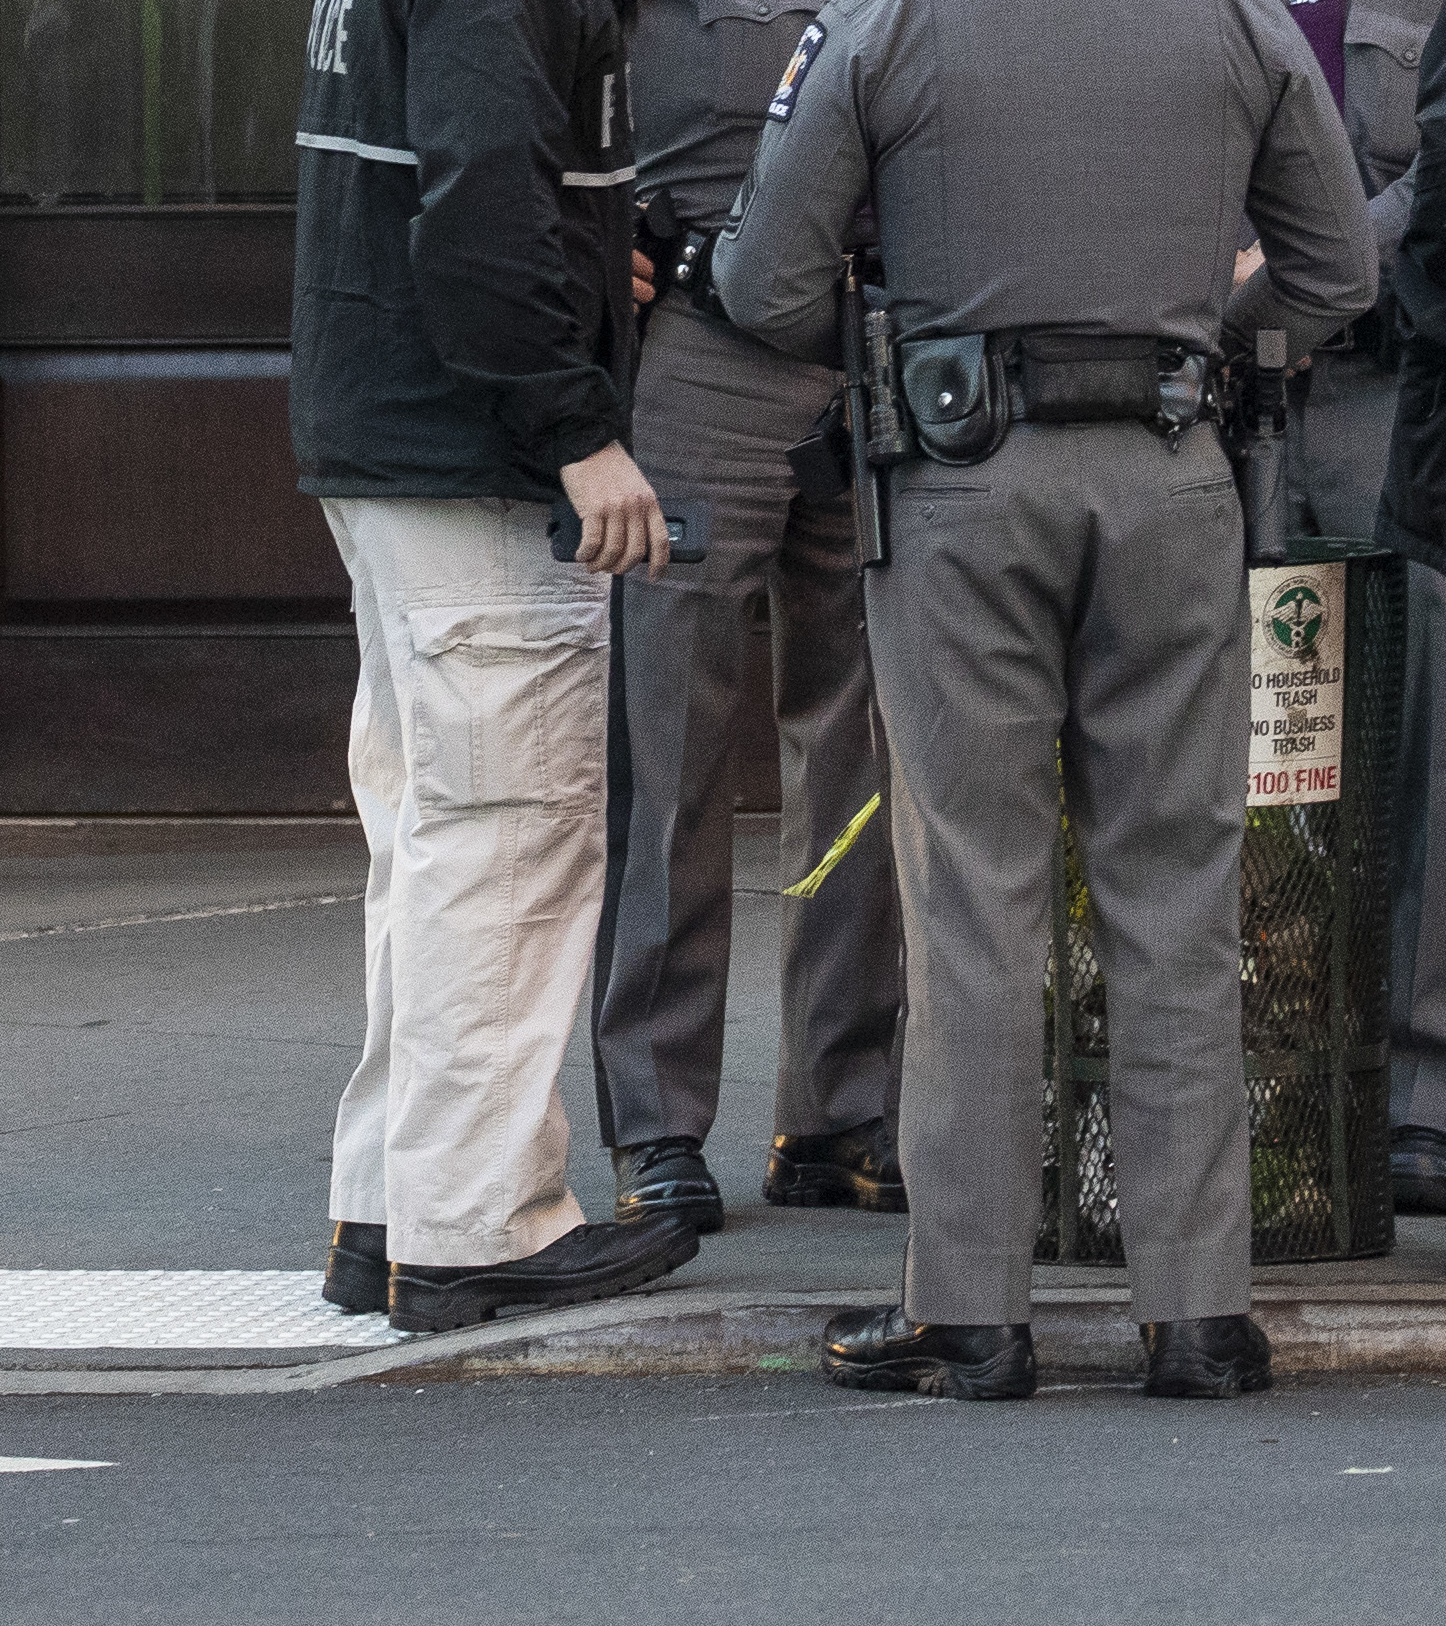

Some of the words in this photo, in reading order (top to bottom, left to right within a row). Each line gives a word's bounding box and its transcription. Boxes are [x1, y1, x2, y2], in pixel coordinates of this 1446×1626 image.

[1251, 674, 1263, 690] O
[1266, 666, 1341, 690] HOUSEHOLD
[1273, 690, 1318, 709] TRASH
[1271, 737, 1316, 756] TRASH
[1295, 766, 1337, 793] FINE
